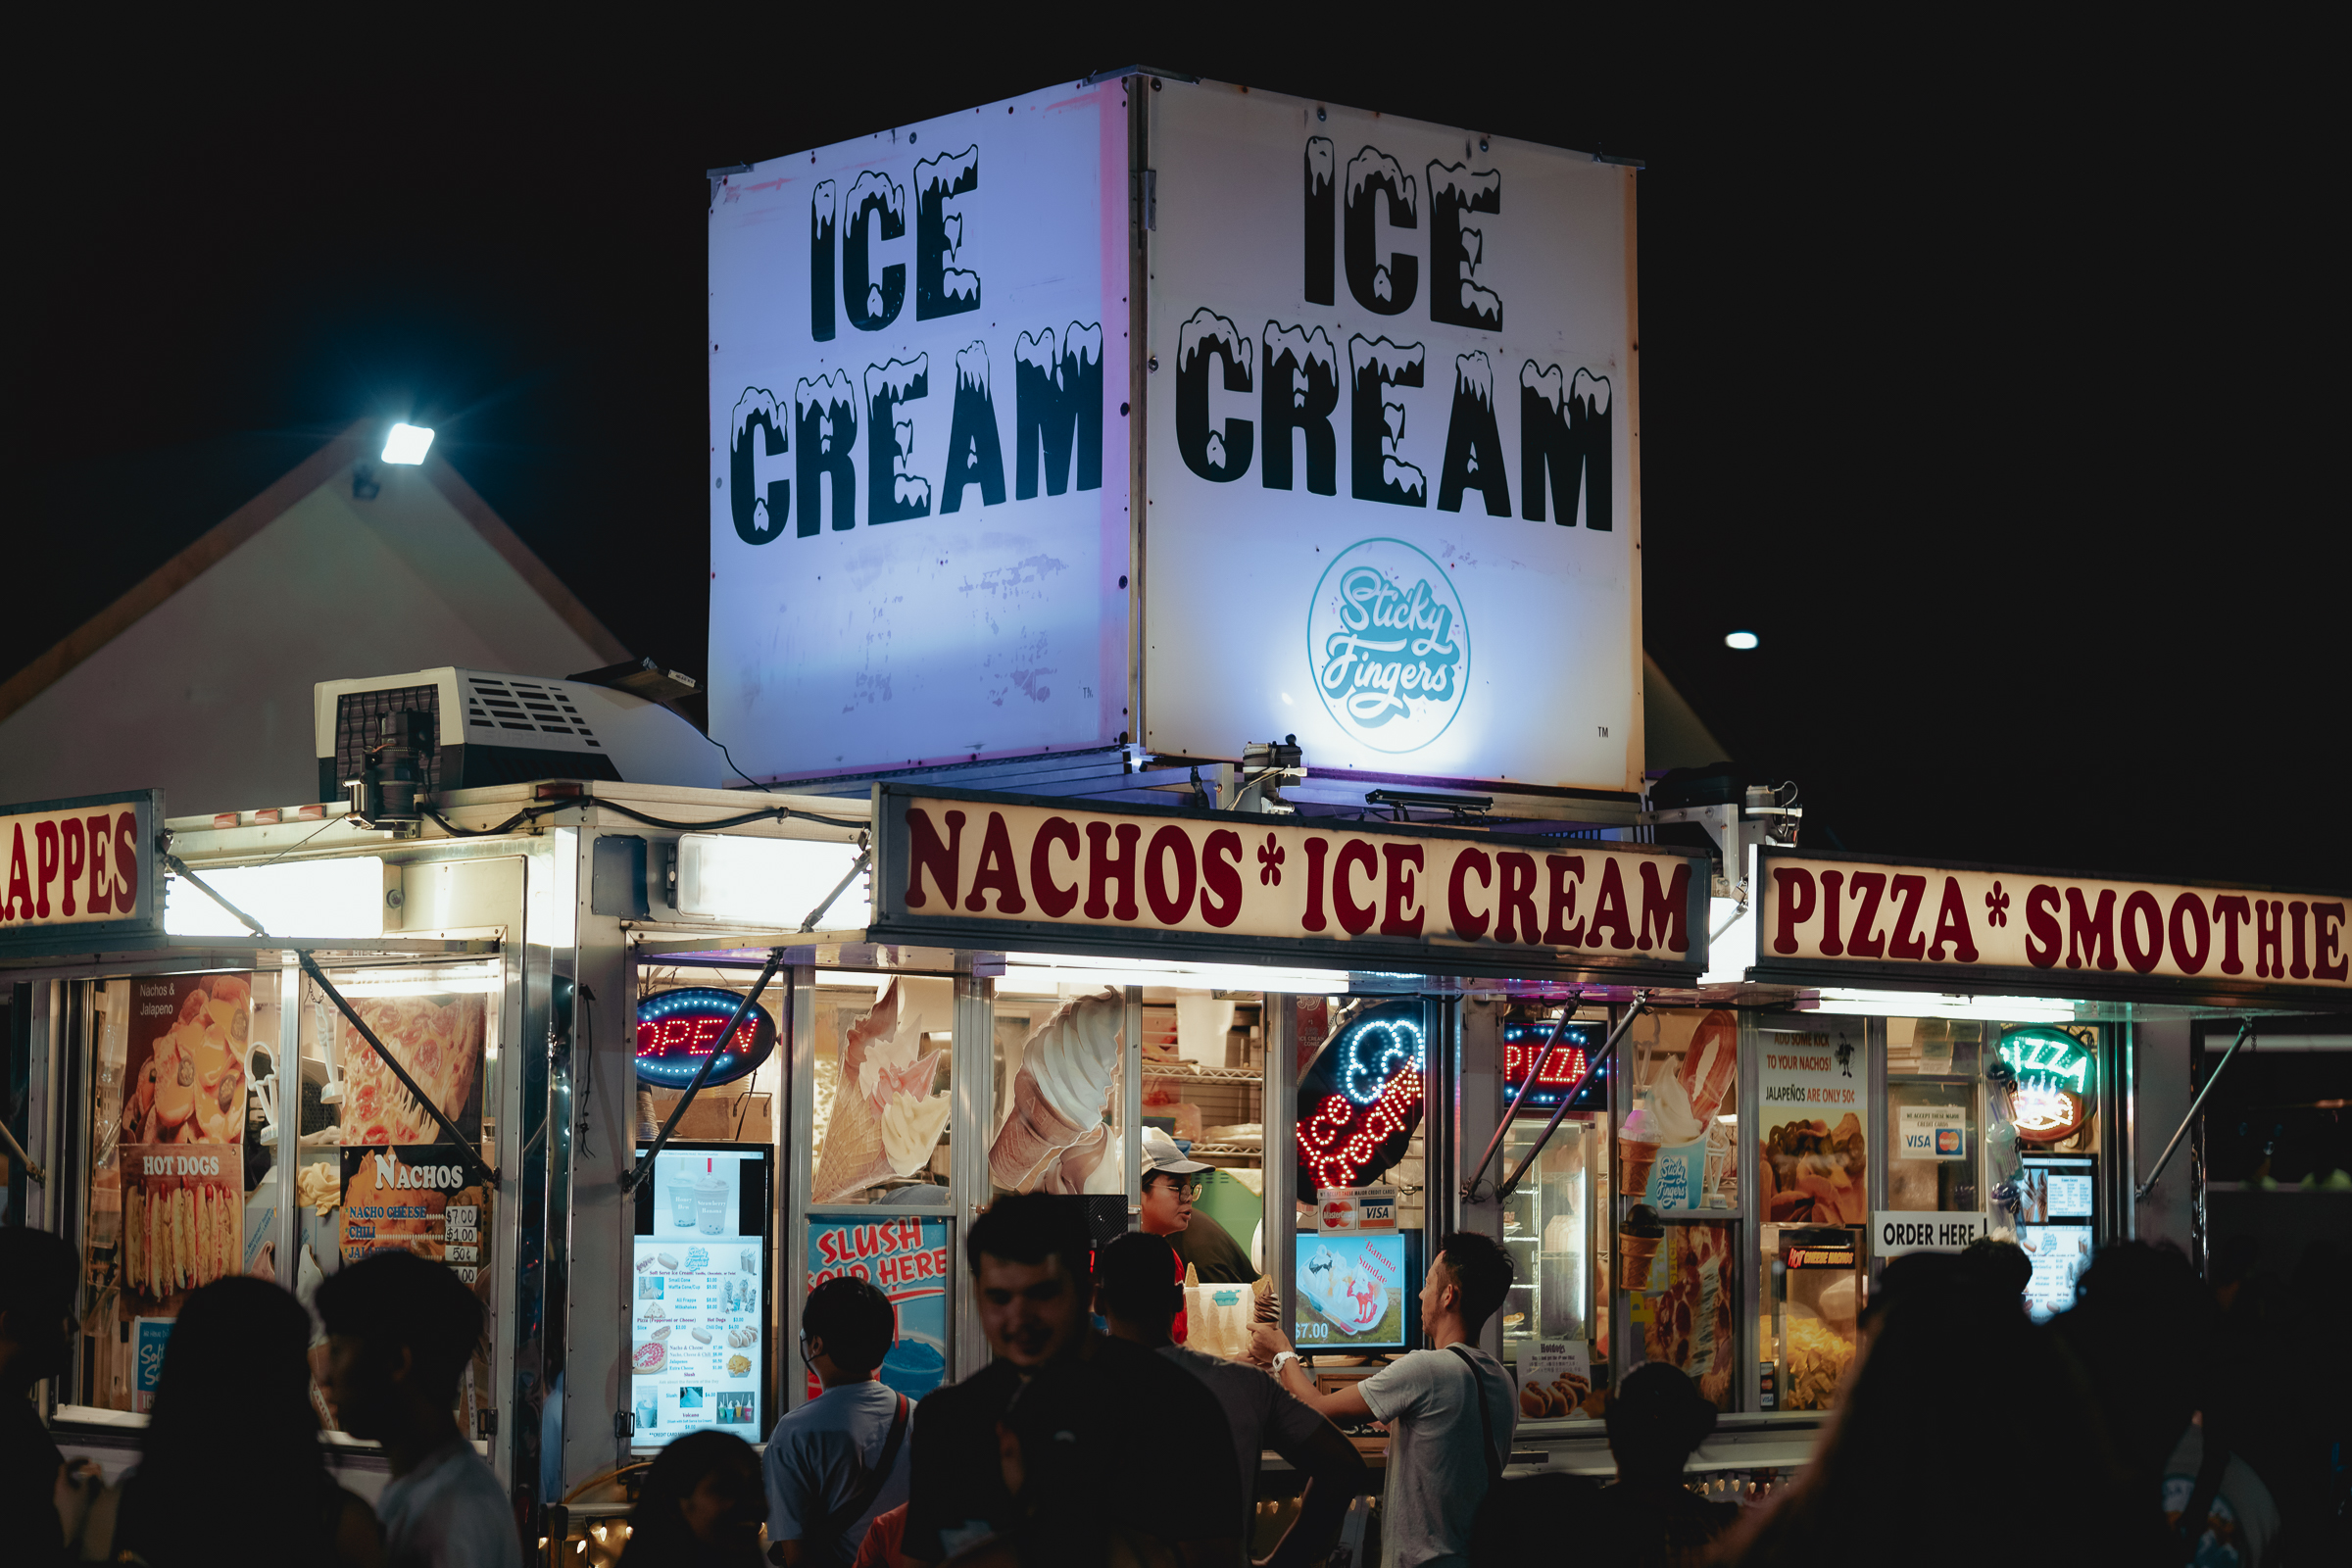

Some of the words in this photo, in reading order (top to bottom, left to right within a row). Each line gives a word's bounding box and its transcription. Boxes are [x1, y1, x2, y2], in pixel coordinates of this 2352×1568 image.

[810, 143, 981, 342] ICE
[1304, 135, 1503, 332] ICE
[1175, 306, 1613, 532] CREAM
[730, 319, 1103, 546] CREAM
[1341, 567, 1453, 657] Sticky
[1323, 633, 1449, 719] Fingers
[1597, 726, 1609, 738] TM
[0, 810, 138, 923] APPES
[905, 807, 1244, 928] NACHOS
[1301, 836, 1426, 940] ICE
[1447, 847, 1692, 953] CREAM
[1773, 866, 1980, 962] PIZZA
[2025, 883, 2349, 982] SMOOTHIE
[139, 983, 168, 997] Nachos
[169, 982, 175, 996] &
[139, 1003, 173, 1017] Jalapeno
[637, 1018, 759, 1057] OPEN
[1774, 1032, 1790, 1045] ADD
[1791, 1033, 1812, 1047] SOME
[1813, 1033, 1830, 1048] KICK
[1506, 1045, 1588, 1083] PIZZA
[1767, 1054, 1777, 1069] TO
[1778, 1054, 1797, 1070] YOUR
[1799, 1055, 1832, 1071] NACHOS!
[1766, 1083, 1805, 1102] JALAPEÑOS
[1806, 1088, 1821, 1102] ARE
[1822, 1088, 1841, 1103] ONLY
[1905, 1135, 1931, 1148] VISA
[143, 1155, 173, 1175] HOT
[177, 1155, 220, 1176] DOGS
[349, 1206, 384, 1219] NACHO
[386, 1206, 427, 1219] CHEESE
[446, 1208, 474, 1224] $7.00
[1366, 1207, 1389, 1219] VISA
[349, 1226, 376, 1239] CHILI
[446, 1227, 474, 1244] $1.00
[817, 1216, 923, 1265] SLUSH
[1883, 1222, 1935, 1246] ORDER
[1938, 1223, 1975, 1246] HERE
[878, 1248, 947, 1285] HERE
[1357, 1254, 1388, 1285] Sundae
[1669, 1239, 1678, 1285] SLICE
[1788, 1248, 1805, 1268] HOT
[1803, 1251, 1829, 1264] CHEESE
[1828, 1251, 1854, 1264] NACHOS
[1296, 1322, 1329, 1340] $7.00
[140, 1344, 165, 1368] Soft
